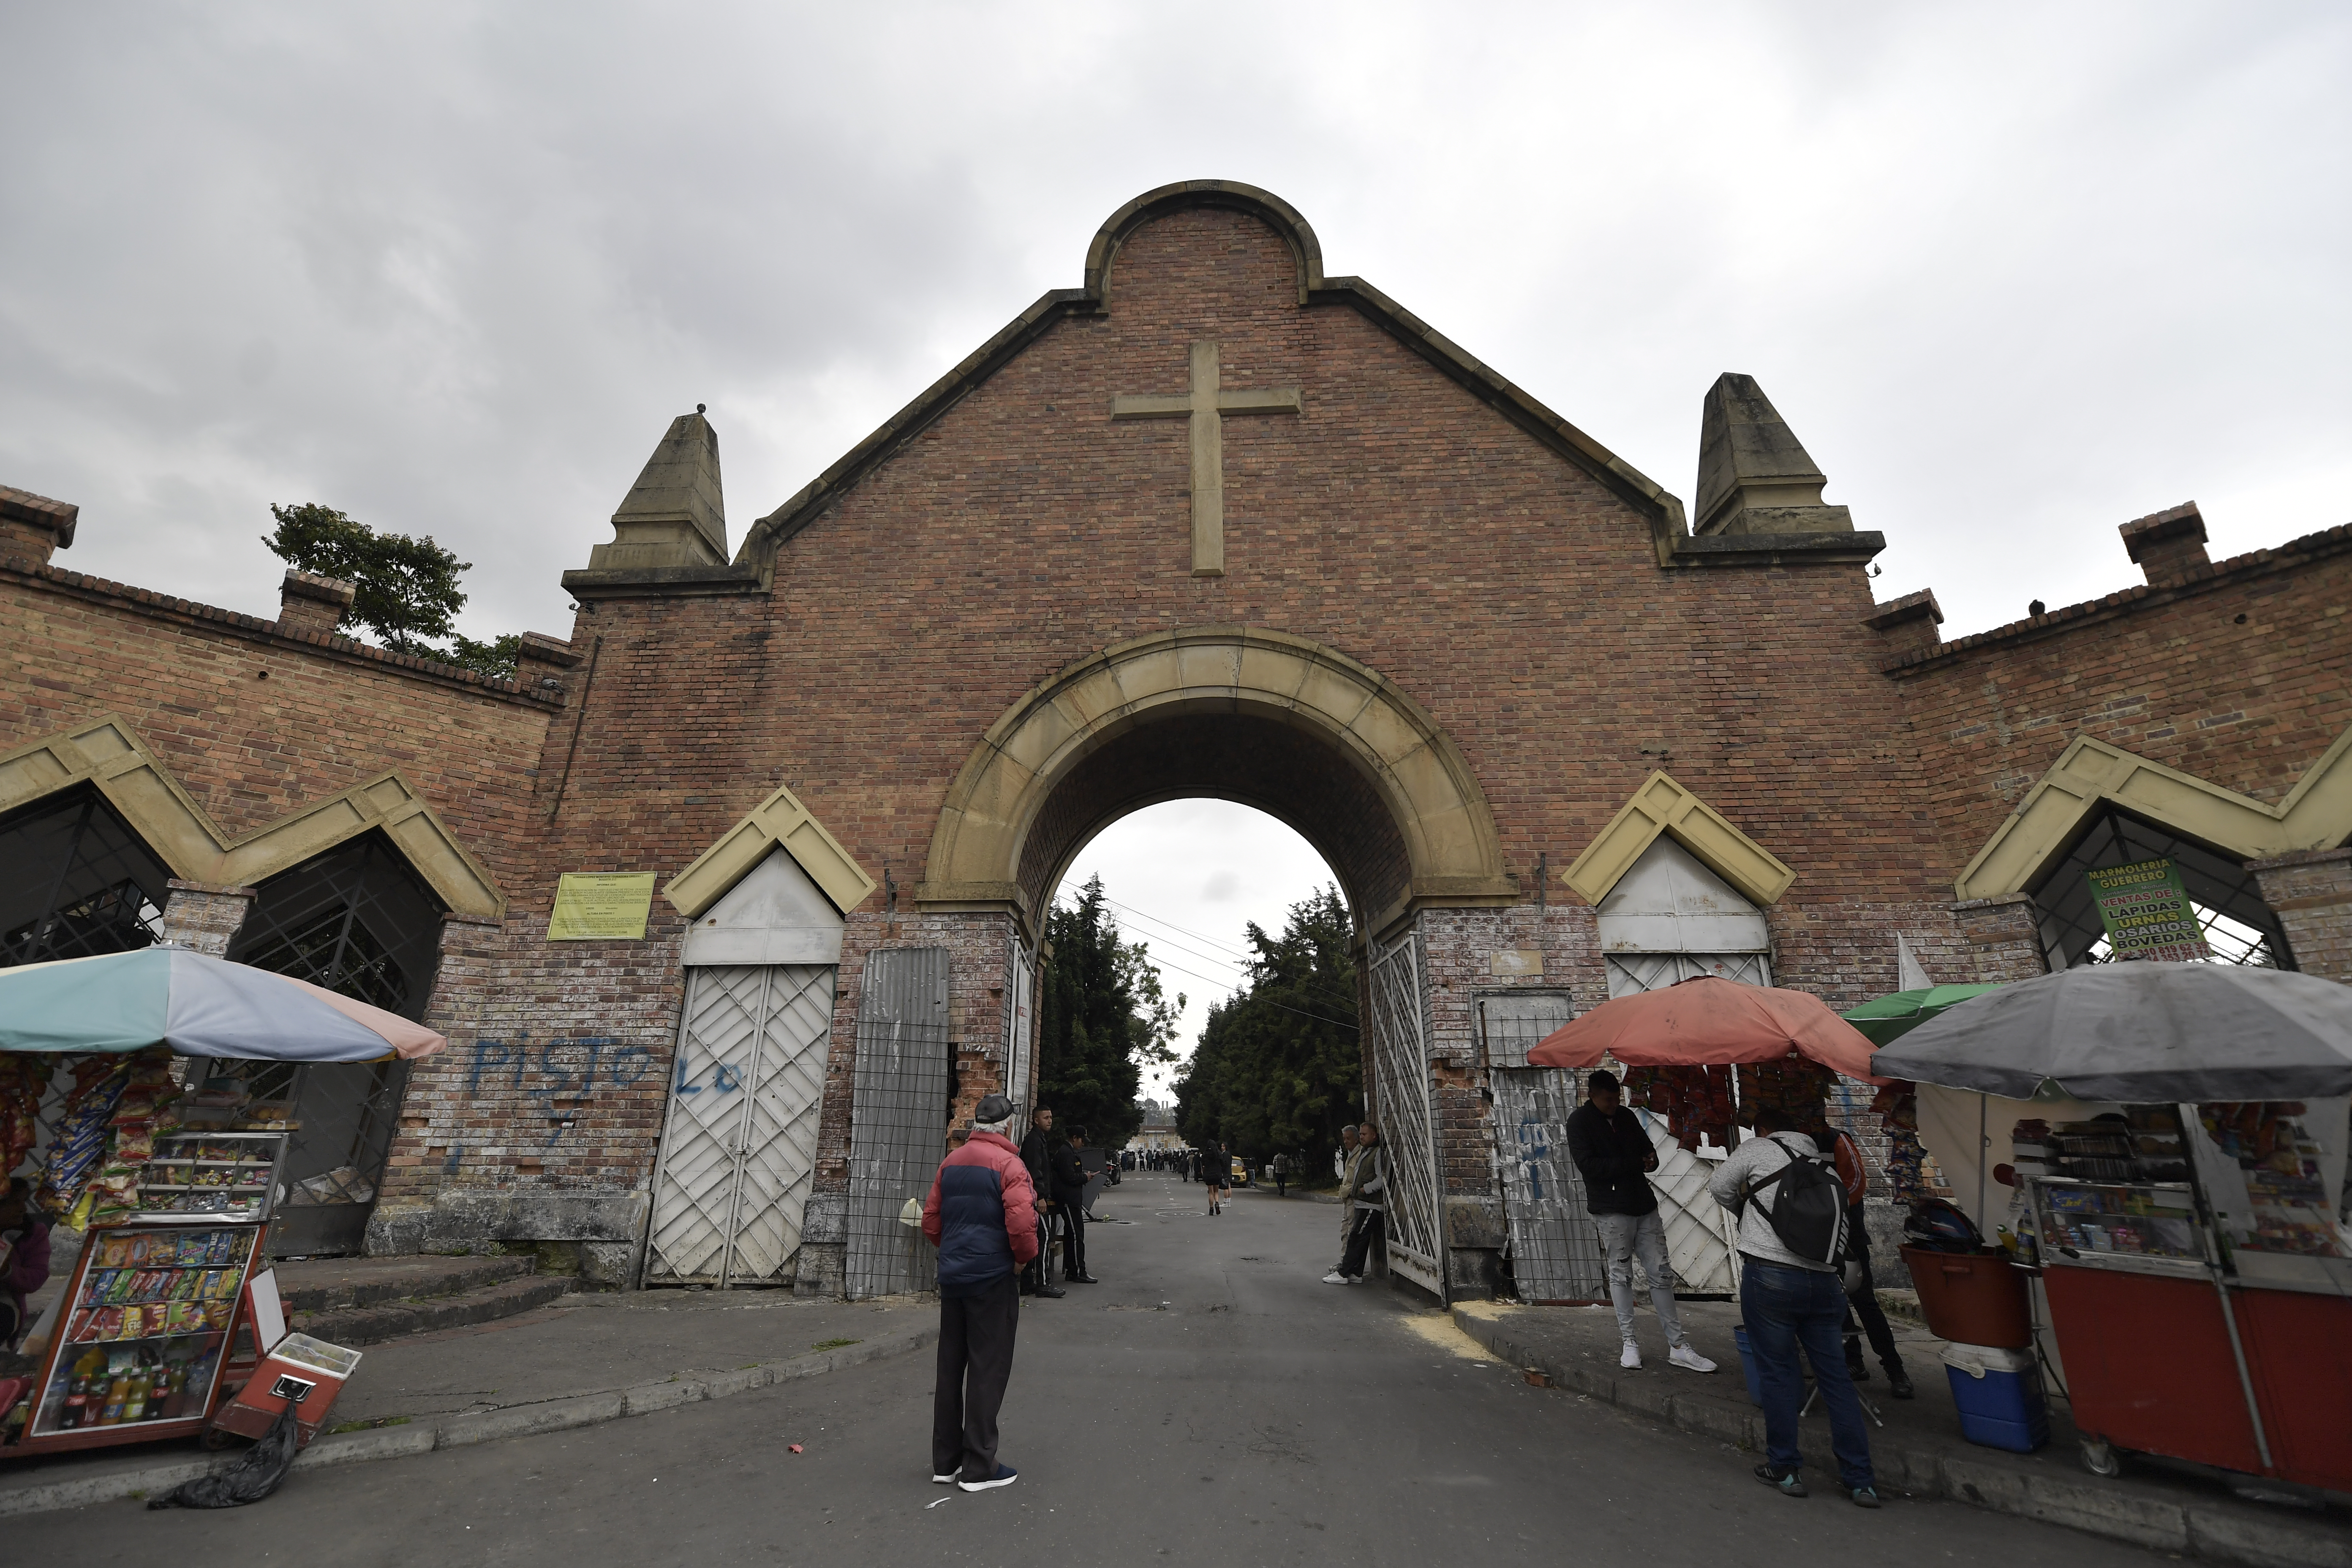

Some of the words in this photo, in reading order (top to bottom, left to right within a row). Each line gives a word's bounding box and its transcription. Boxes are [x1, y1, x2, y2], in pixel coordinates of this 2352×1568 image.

[2088, 858, 2171, 880] MARMOLERÍA
[2100, 870, 2166, 888] GUERRERO
[2100, 892, 2151, 907] VENTAS
[2154, 889, 2173, 899] DE
[2102, 889, 2132, 898] Container
[2142, 882, 2166, 890] Modulo
[2108, 901, 2181, 918] LÁPIDAS
[2118, 912, 2180, 928] URNAS
[2114, 920, 2193, 939] OSARIOS
[2116, 931, 2199, 949] BOVEDAS
[2117, 950, 2135, 959] Cel:
[2137, 947, 2156, 956] 310
[2158, 945, 2177, 954] 819
[2179, 943, 2193, 951] 62
[2194, 941, 2208, 950] 39
[2161, 953, 2180, 962] 353
[2182, 951, 2195, 959] 20
[2197, 949, 2210, 957] 71
